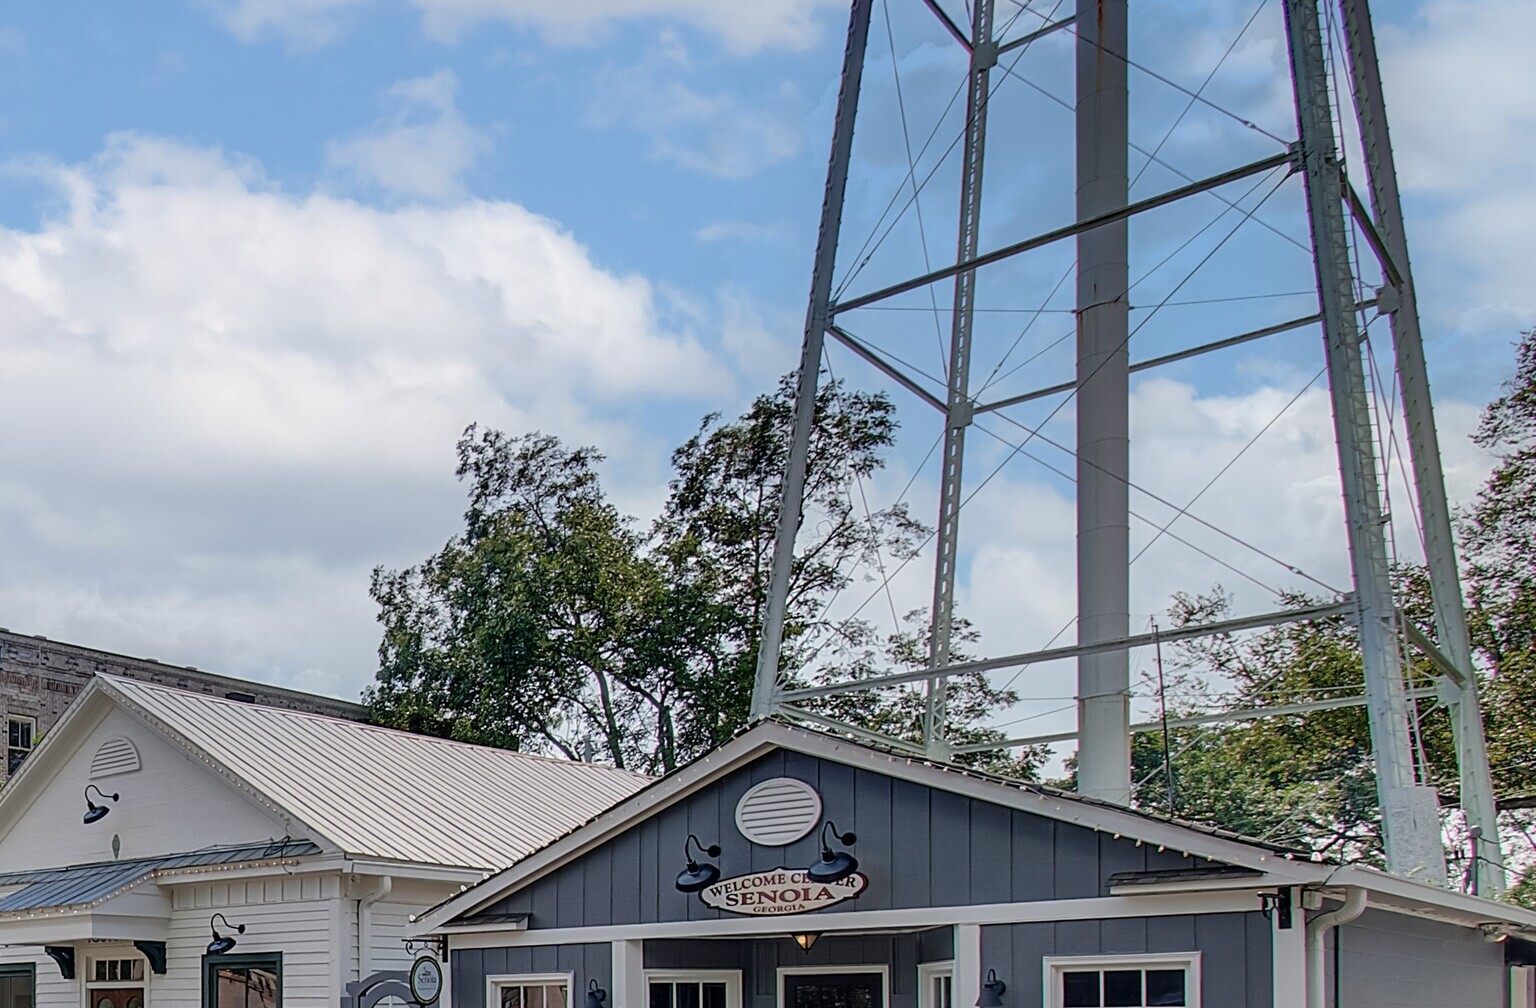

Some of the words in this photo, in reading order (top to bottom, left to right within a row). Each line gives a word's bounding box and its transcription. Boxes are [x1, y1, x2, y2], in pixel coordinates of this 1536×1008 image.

[709, 873, 786, 897] WELCOME
[790, 872, 855, 888] CEER
[725, 886, 835, 907] SENOIA
[753, 904, 805, 913] GEORGIA
